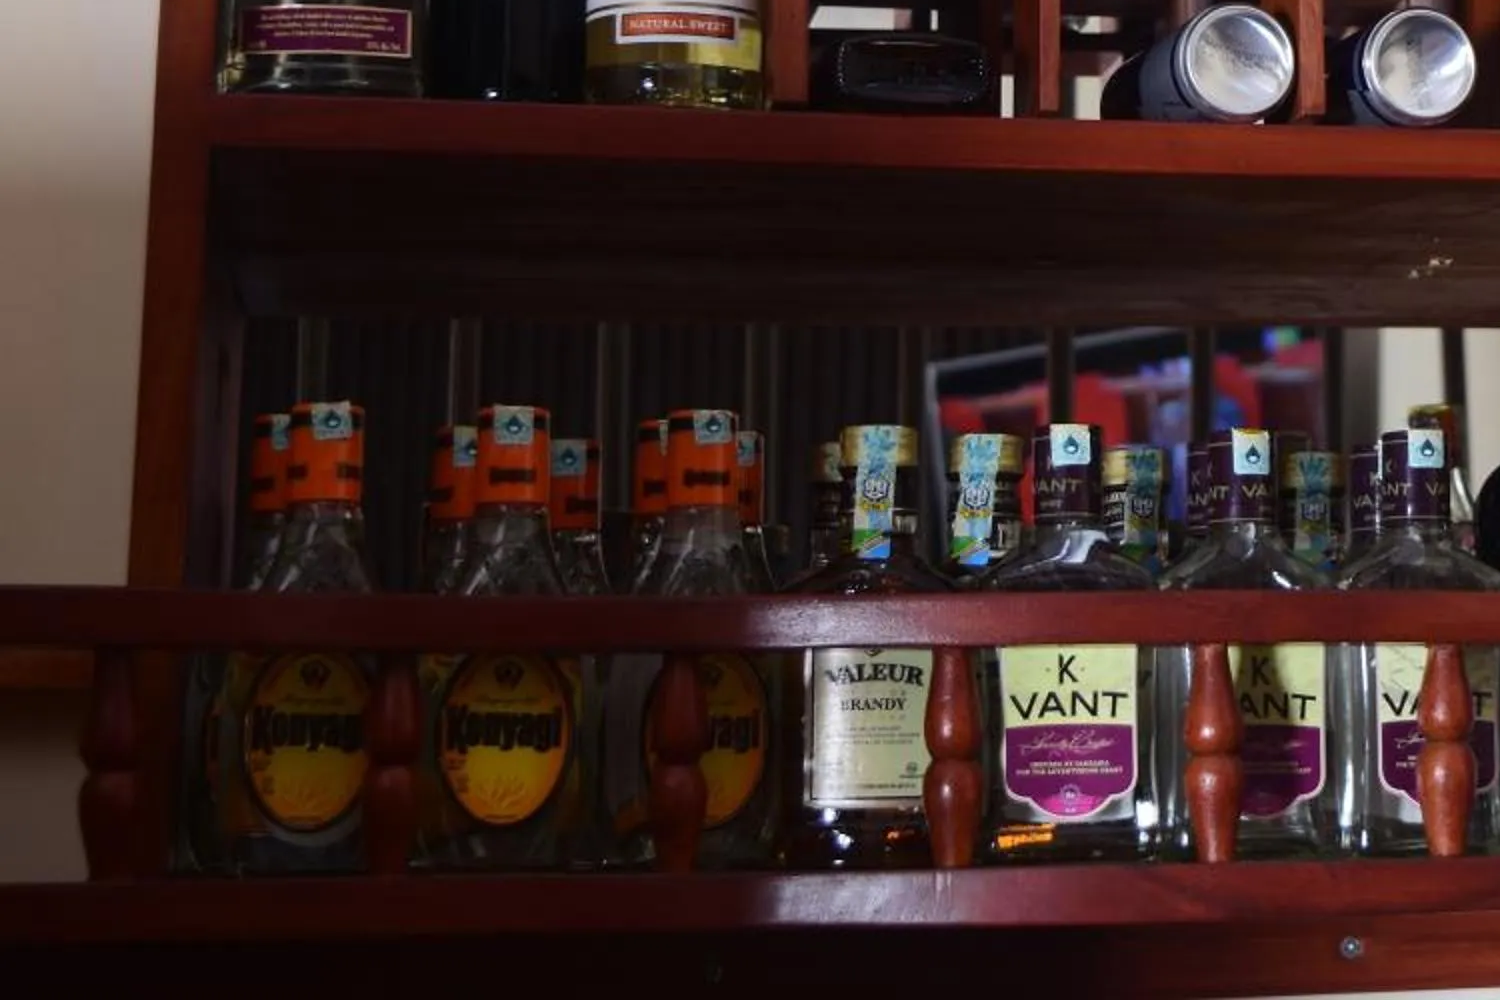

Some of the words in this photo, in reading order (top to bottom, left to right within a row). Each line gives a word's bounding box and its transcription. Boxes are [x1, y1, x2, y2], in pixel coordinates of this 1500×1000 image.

[630, 18, 688, 29] NATURAL
[824, 663, 925, 687] VALEUR
[1057, 653, 1079, 685] K
[1251, 656, 1270, 687] K
[840, 697, 908, 711] BRANDY
[1009, 690, 1129, 720] VANT
[1239, 690, 1317, 720] ANT
[449, 703, 562, 754] Konyagi
